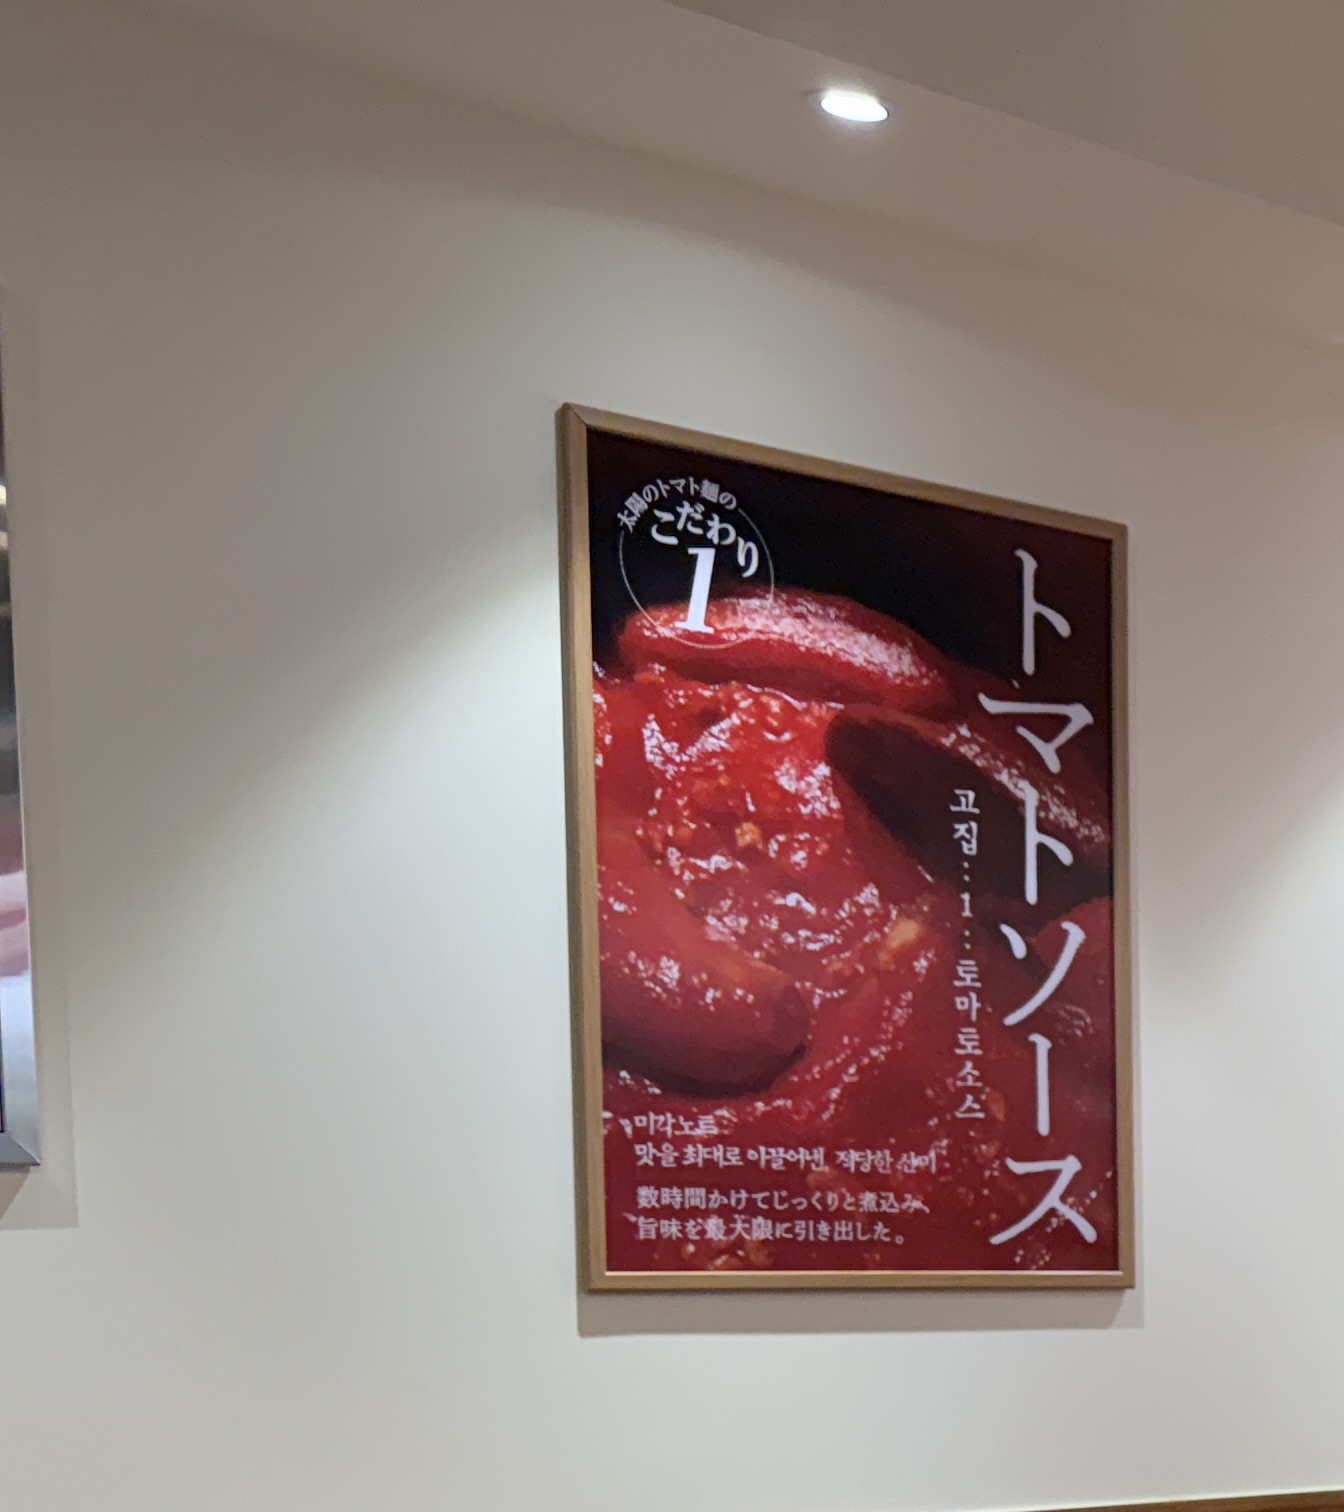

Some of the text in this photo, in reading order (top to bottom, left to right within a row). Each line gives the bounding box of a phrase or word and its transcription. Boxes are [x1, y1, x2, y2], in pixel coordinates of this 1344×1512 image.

[651, 500, 759, 577] こだわり
[674, 547, 716, 634] 1
[978, 547, 1098, 1246] トマトソース
[634, 1142, 678, 1168] 맛을
[682, 1143, 744, 1168] 최대로
[896, 1149, 937, 1175] 산미
